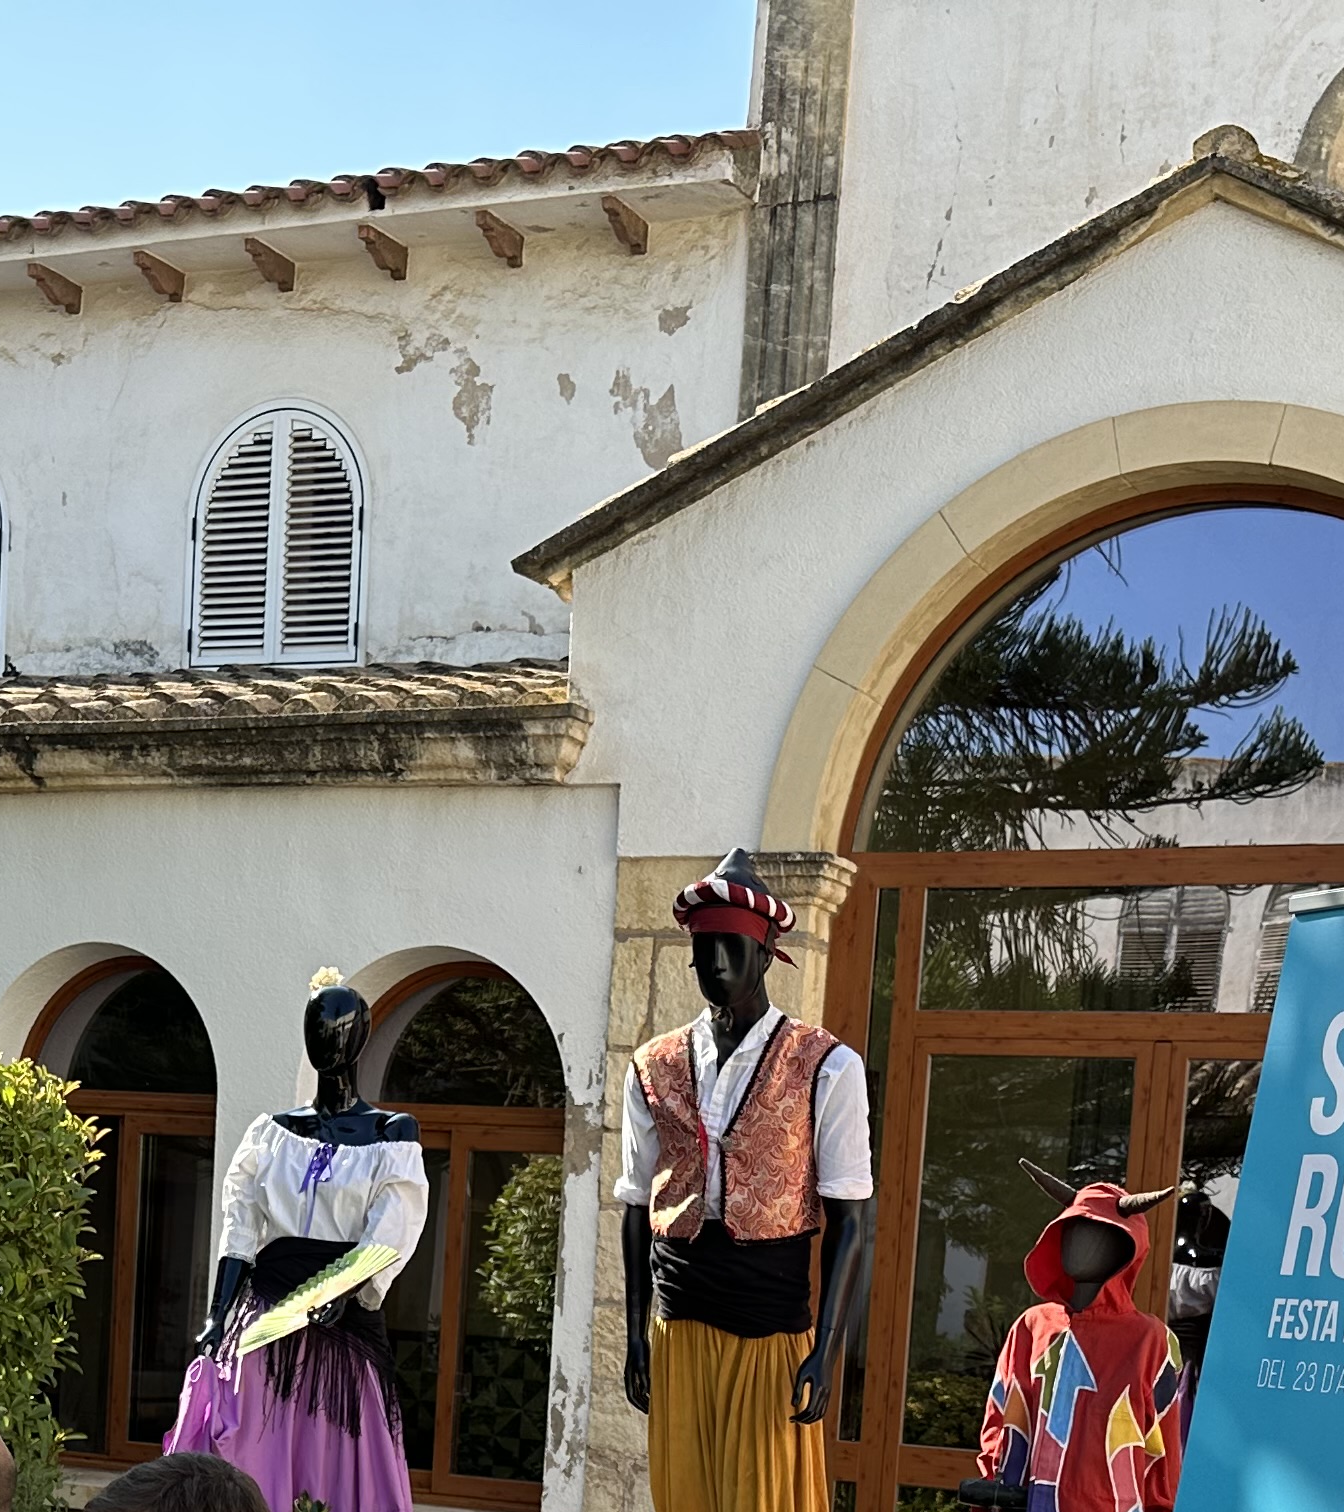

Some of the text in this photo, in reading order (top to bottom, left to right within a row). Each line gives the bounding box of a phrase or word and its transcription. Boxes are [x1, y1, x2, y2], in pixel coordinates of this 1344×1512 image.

[1267, 1297, 1339, 1343] FESTA
[1257, 1358, 1289, 1391] DEL
[1292, 1361, 1319, 1393] 23
